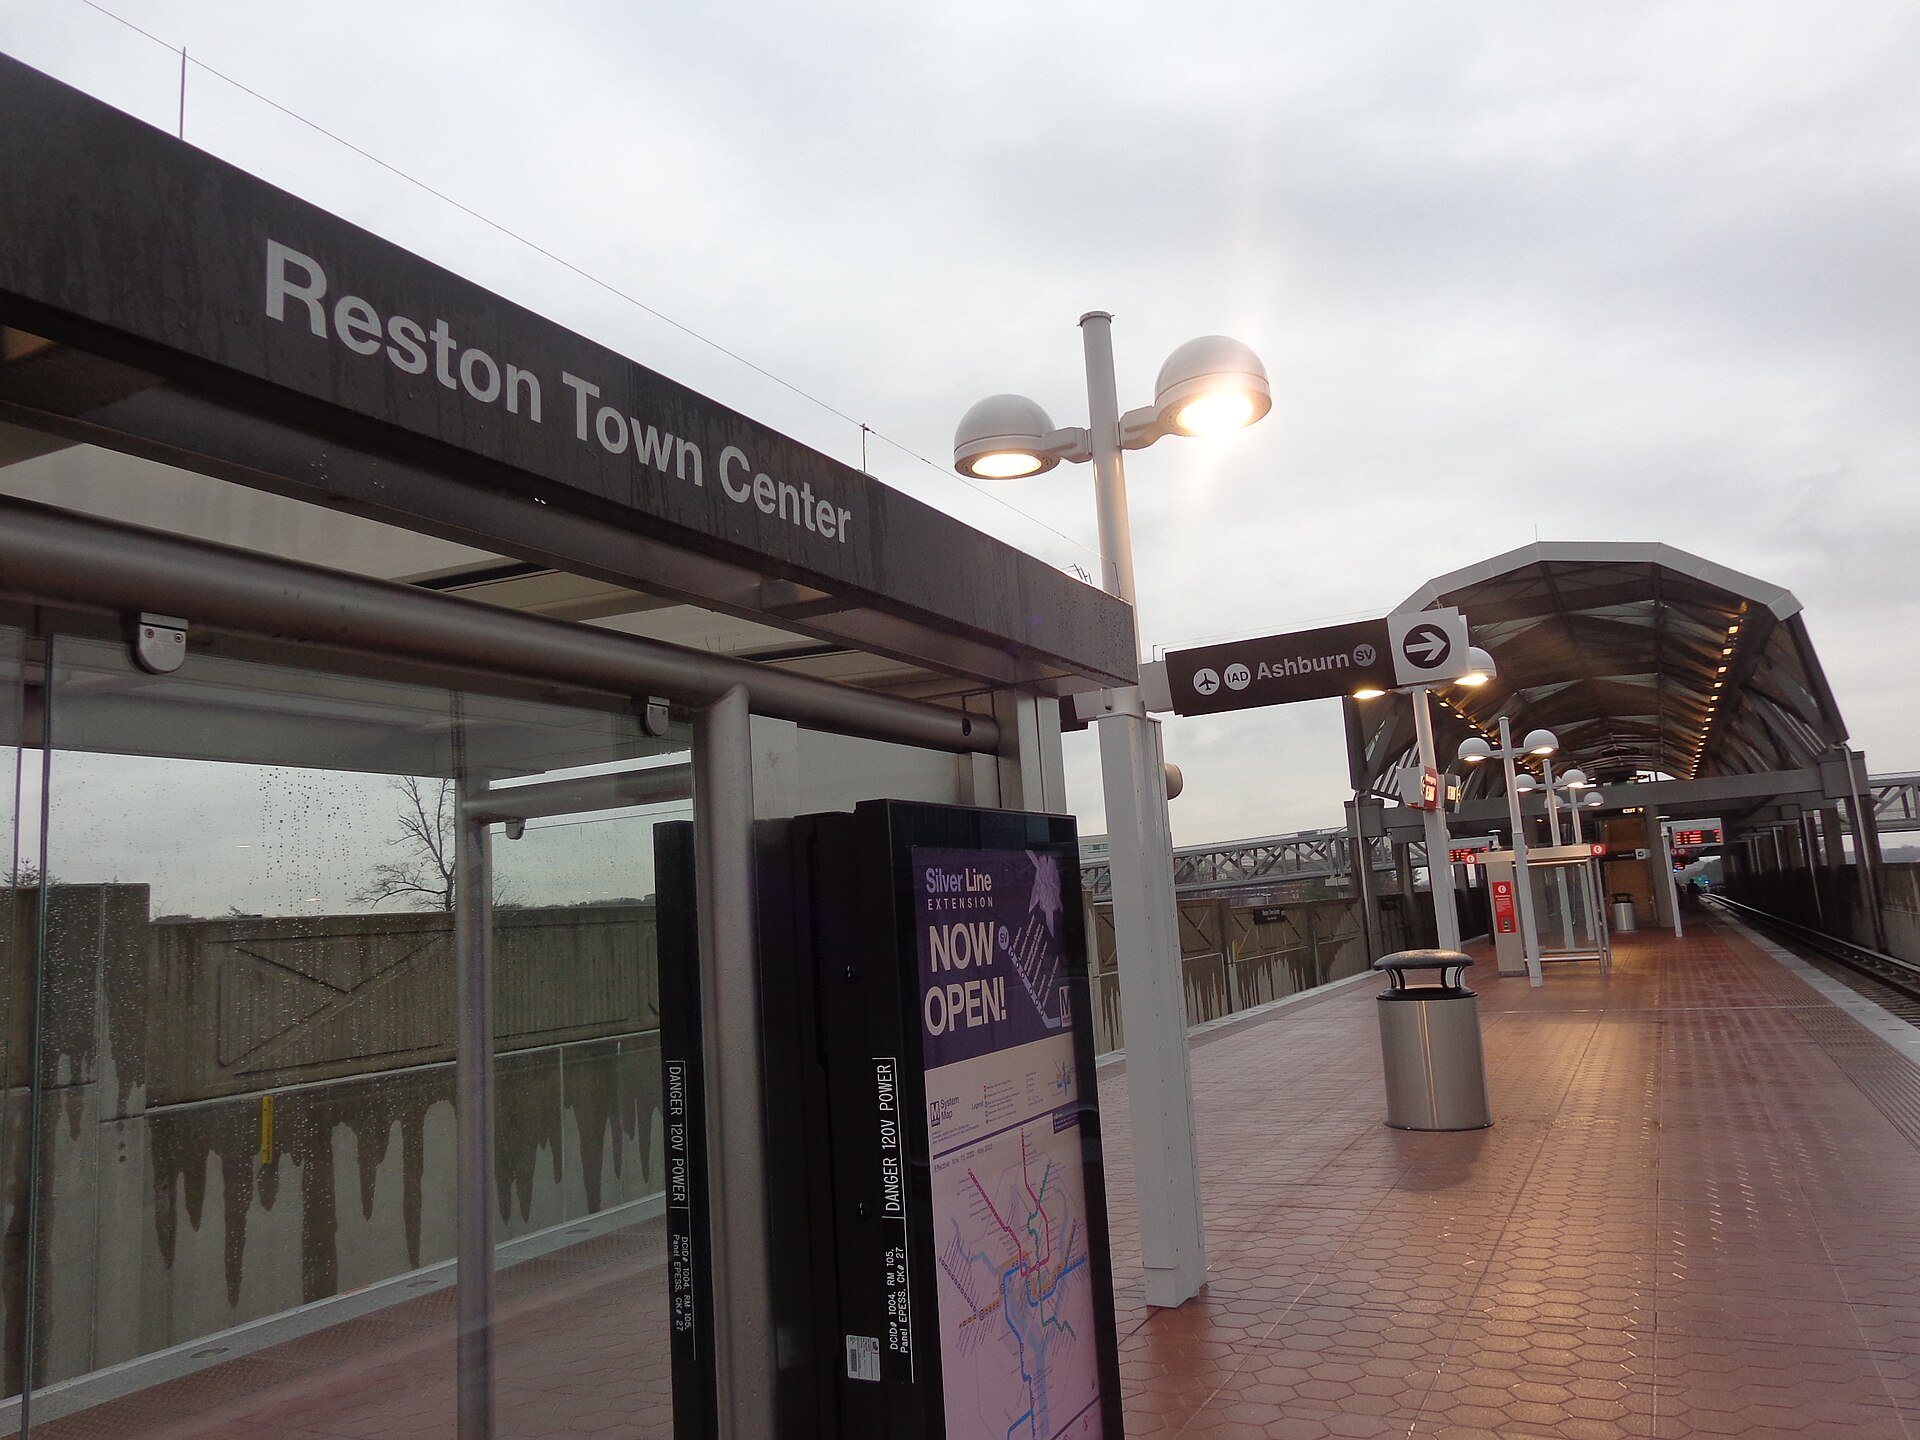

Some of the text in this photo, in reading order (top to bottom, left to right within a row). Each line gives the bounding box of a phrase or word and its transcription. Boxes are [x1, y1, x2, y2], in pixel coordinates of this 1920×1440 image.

[266, 239, 851, 543] Reston Town Center
[1227, 648, 1373, 684] IAD Ashburn SV
[926, 868, 992, 894] Silver Line
[928, 896, 993, 911] EXTENSION
[929, 921, 994, 972] NOW
[924, 976, 1007, 1036] OPEN!
[669, 1066, 685, 1202] DANGER 120V POWER
[877, 1064, 901, 1211] DANGER 120V POWER
[673, 1234, 681, 1257] Panel
[895, 1247, 904, 1259] 27
[886, 1272, 895, 1286] RM
[683, 1294, 691, 1307] RM
[676, 1320, 684, 1331] 27
[900, 1328, 908, 1353] Panel
